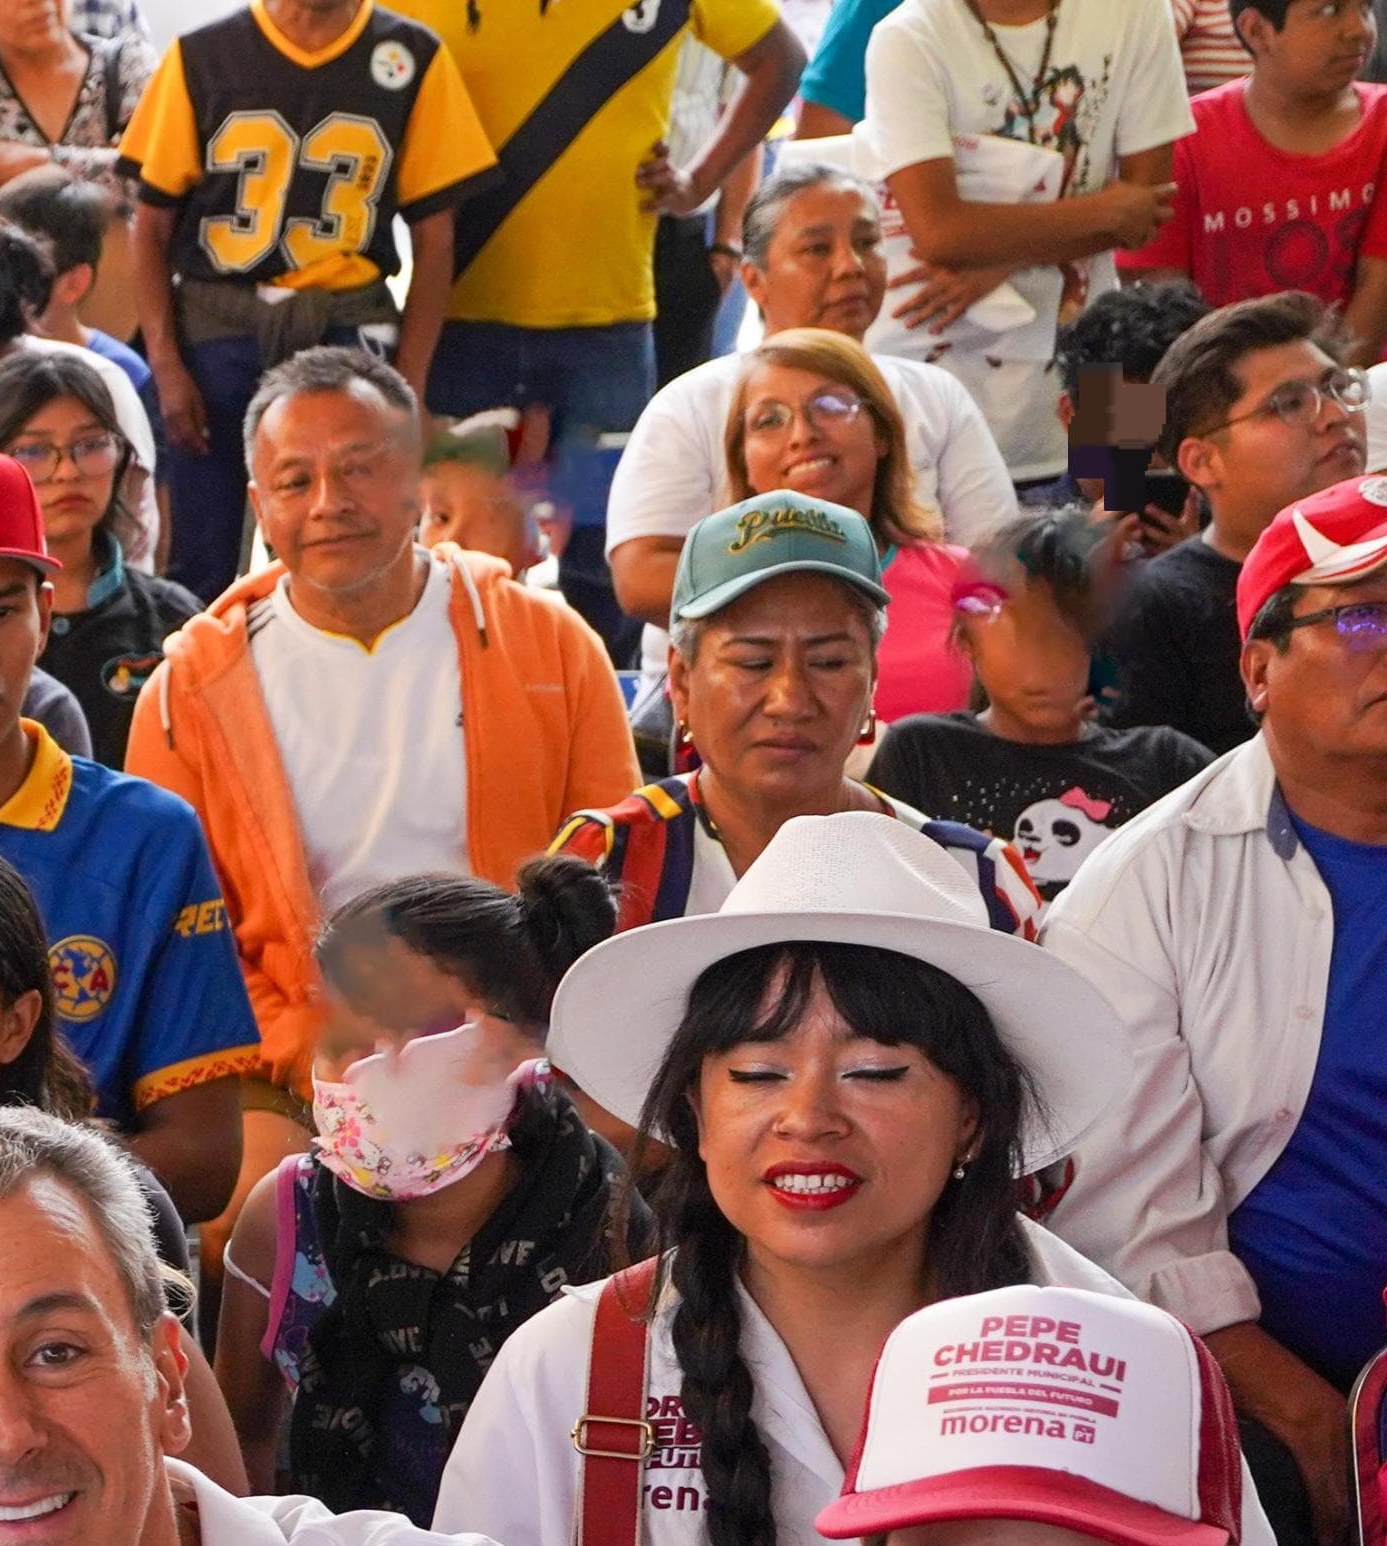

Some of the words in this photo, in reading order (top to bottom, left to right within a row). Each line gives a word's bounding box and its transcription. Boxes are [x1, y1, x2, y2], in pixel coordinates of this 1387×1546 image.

[199, 109, 395, 273] 33
[980, 1315, 1082, 1345] PEPE
[933, 1340, 1127, 1382] CHEDRAUI
[952, 1367, 1024, 1378] PRESIDENTE
[1027, 1368, 1096, 1387] MUNICIPAL
[970, 1387, 984, 1395] LA
[985, 1387, 1026, 1396] PUEBLA
[1028, 1388, 1047, 1397] DEL
[1050, 1390, 1094, 1405] FUTURO
[940, 1413, 1066, 1439] morena
